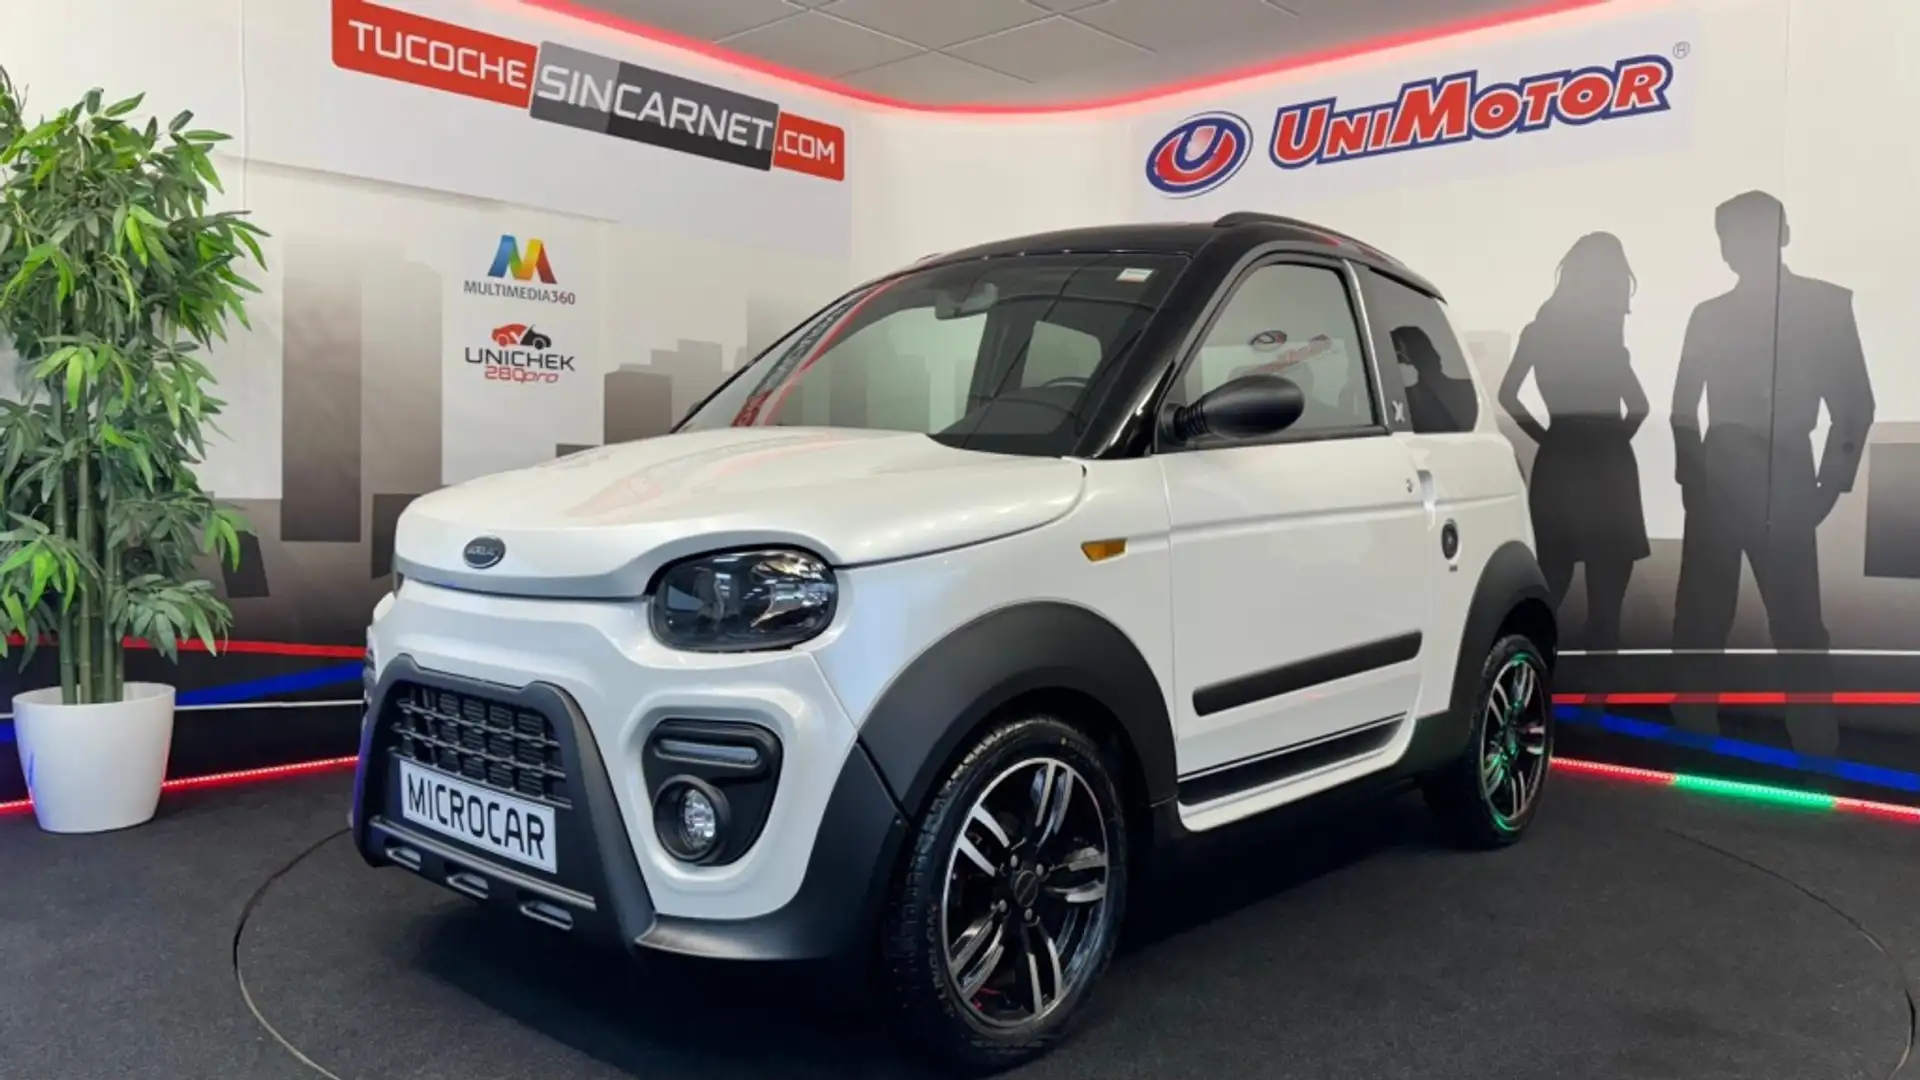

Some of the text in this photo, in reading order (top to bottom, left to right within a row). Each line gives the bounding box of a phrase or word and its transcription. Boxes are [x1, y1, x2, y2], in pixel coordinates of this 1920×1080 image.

[463, 280, 576, 305] MULTIMEDIA360
[464, 347, 575, 372] UNICHEK
[484, 365, 559, 384] 280pro
[407, 772, 545, 861] MICROCAR
